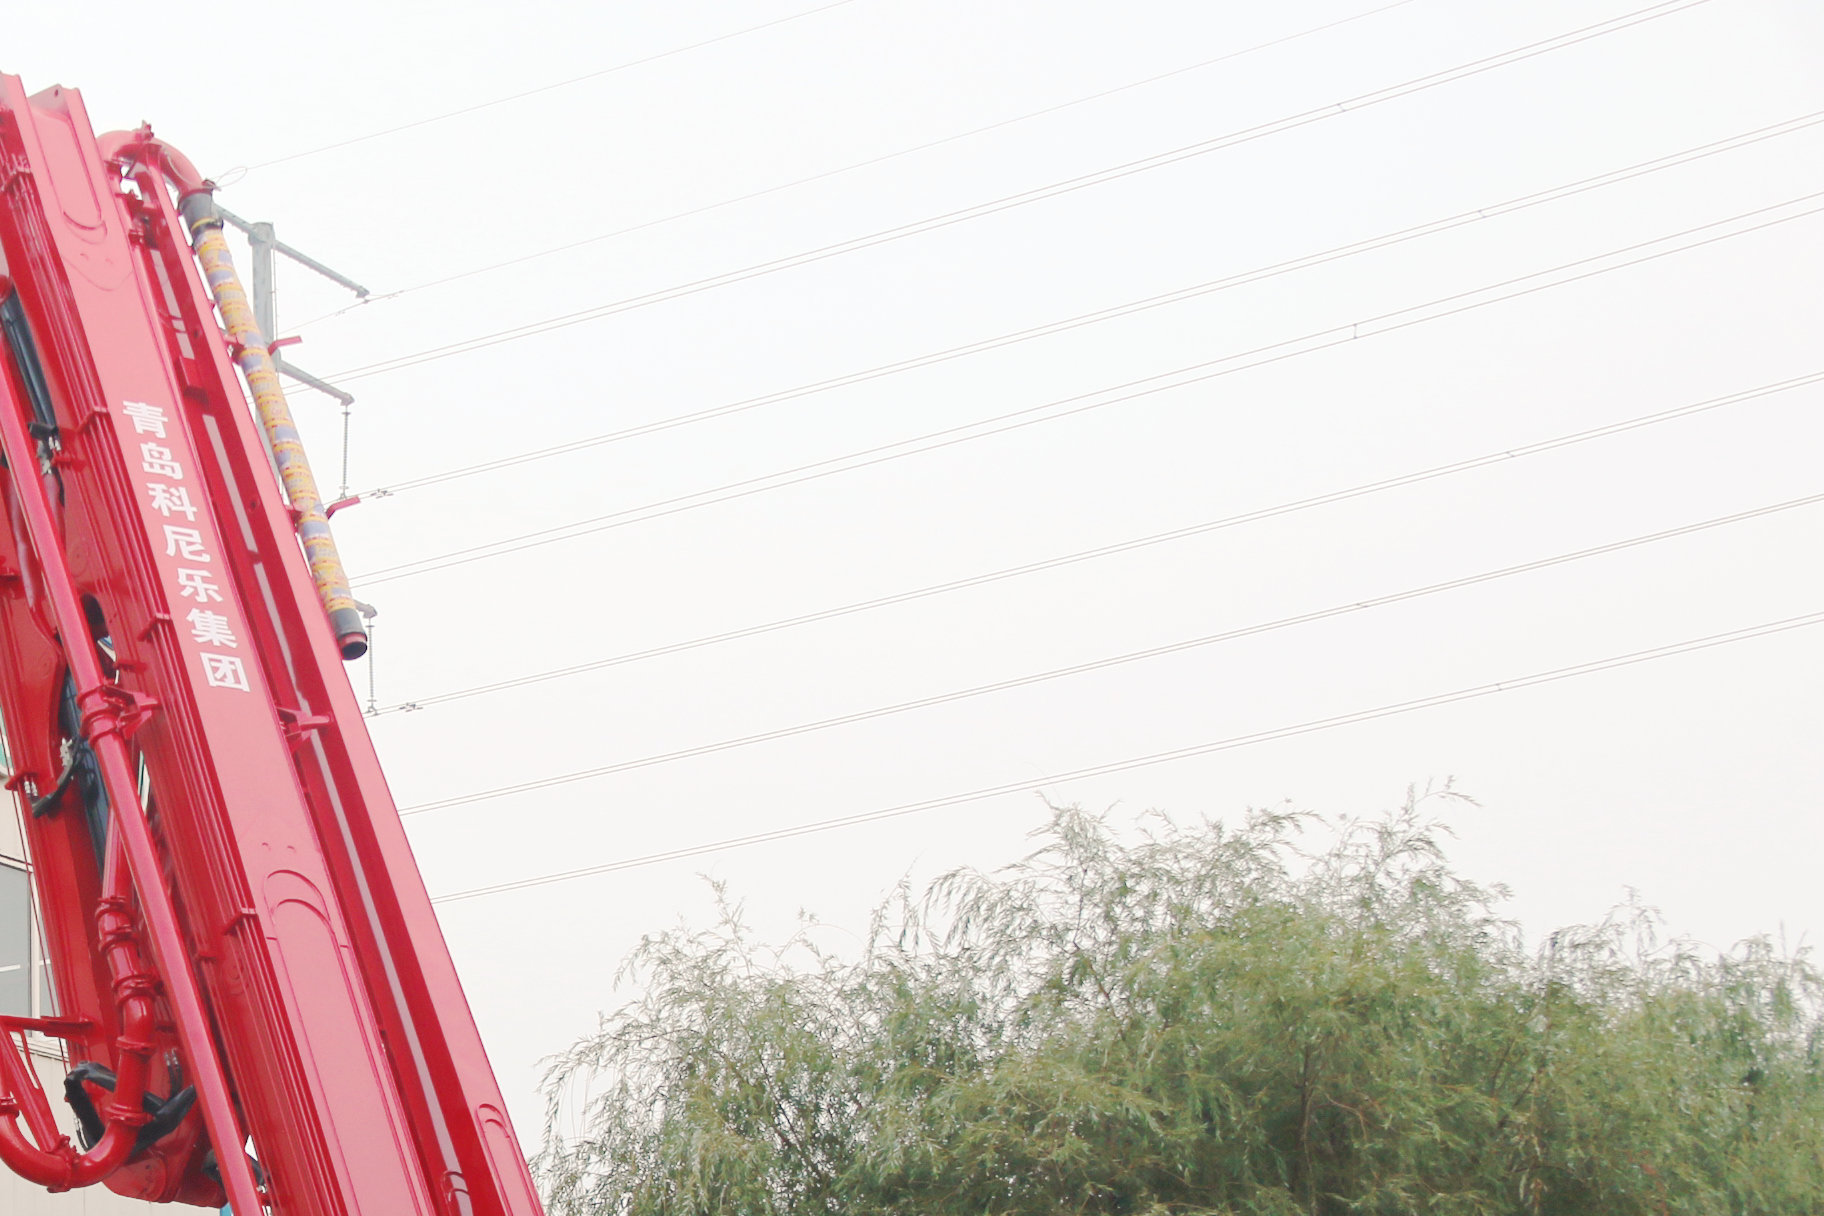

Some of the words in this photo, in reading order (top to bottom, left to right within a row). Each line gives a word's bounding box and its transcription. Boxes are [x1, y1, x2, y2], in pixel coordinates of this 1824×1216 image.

[122, 400, 251, 692] 青岛科尼乐集团
